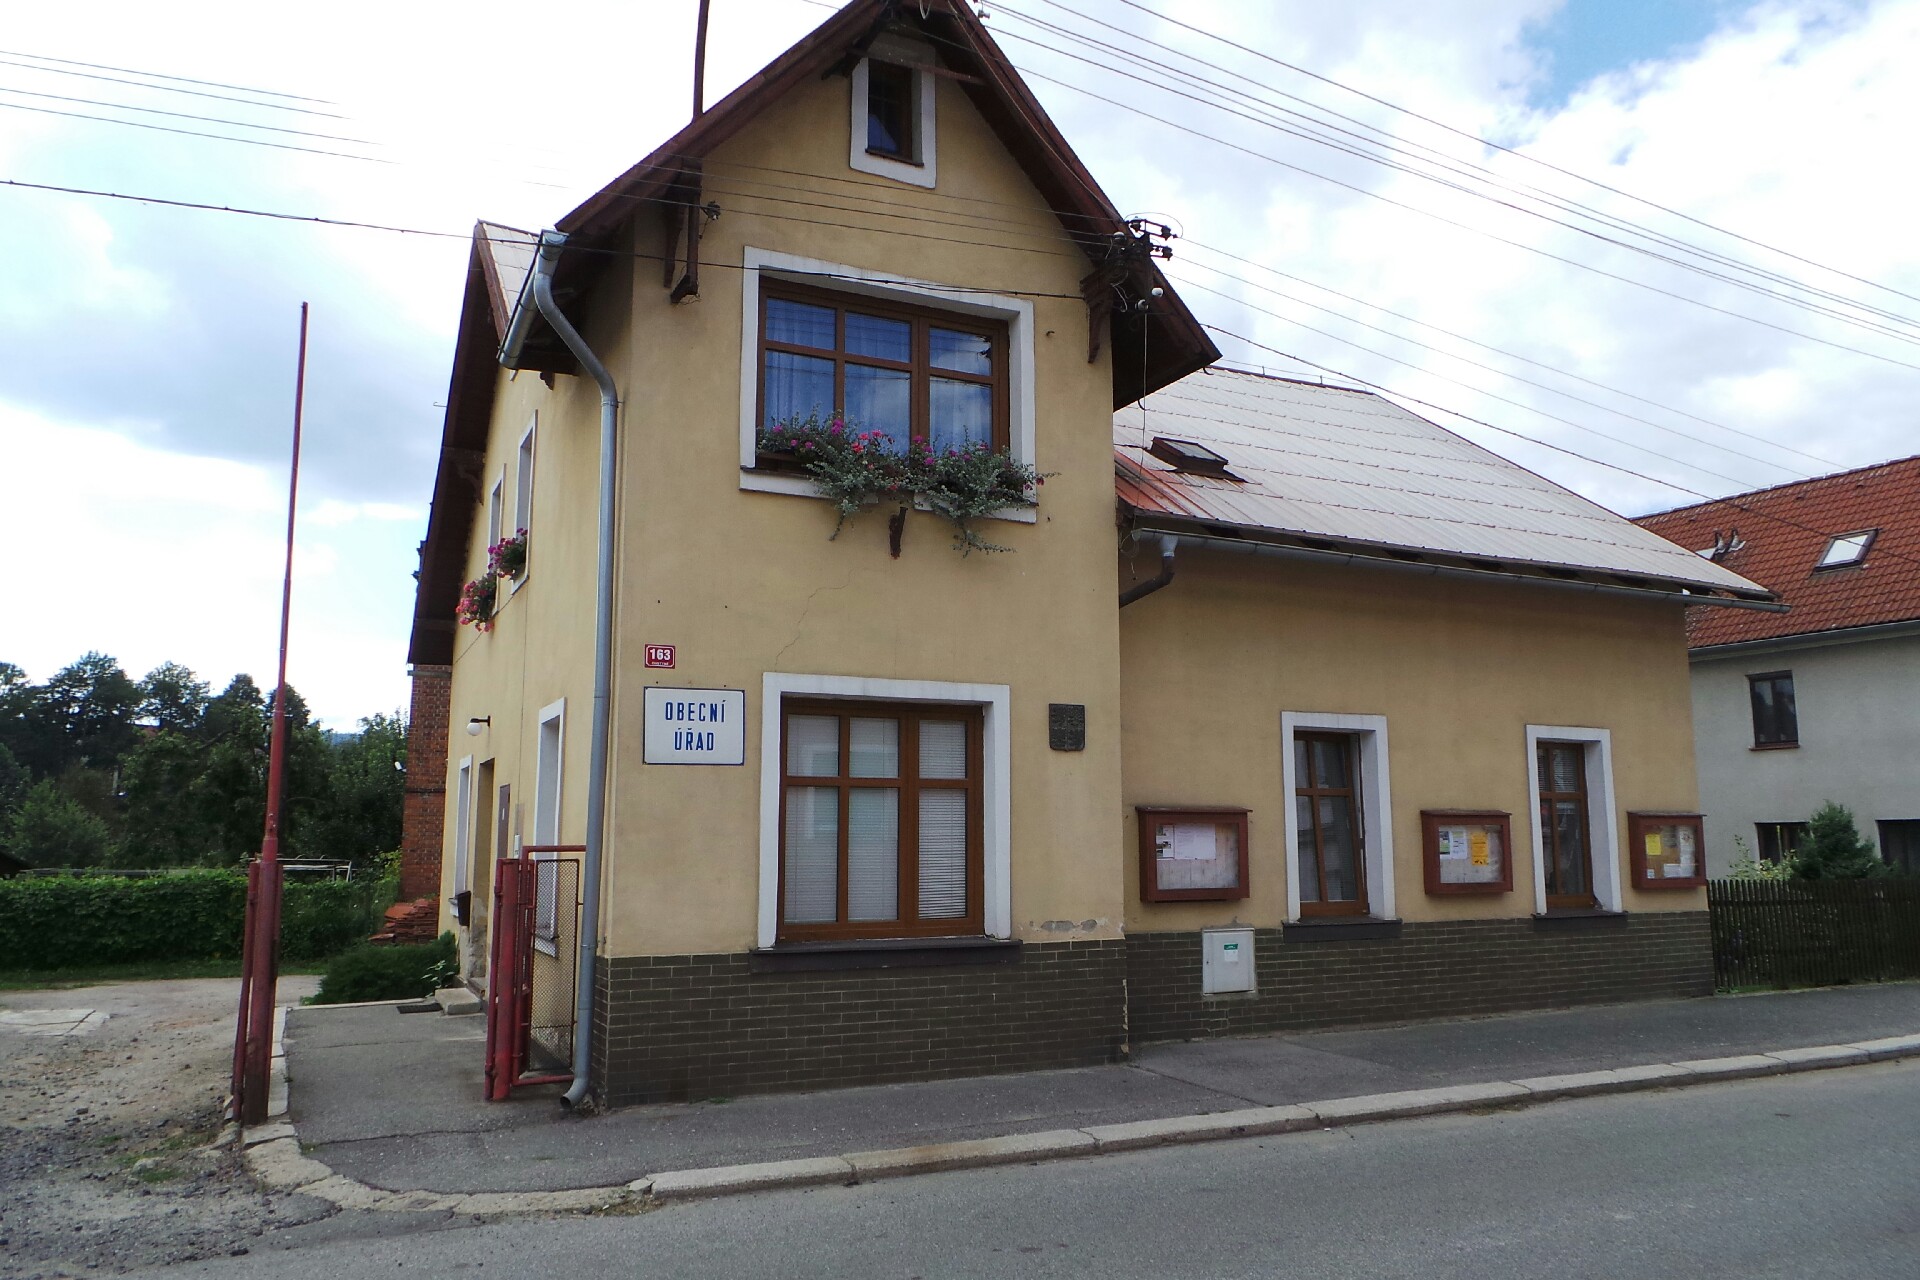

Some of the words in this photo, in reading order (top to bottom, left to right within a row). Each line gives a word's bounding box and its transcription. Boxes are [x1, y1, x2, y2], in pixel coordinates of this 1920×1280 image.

[649, 648, 671, 660] 163
[665, 699, 726, 723] OBECNÍ
[674, 727, 715, 751] ÚŘAD
